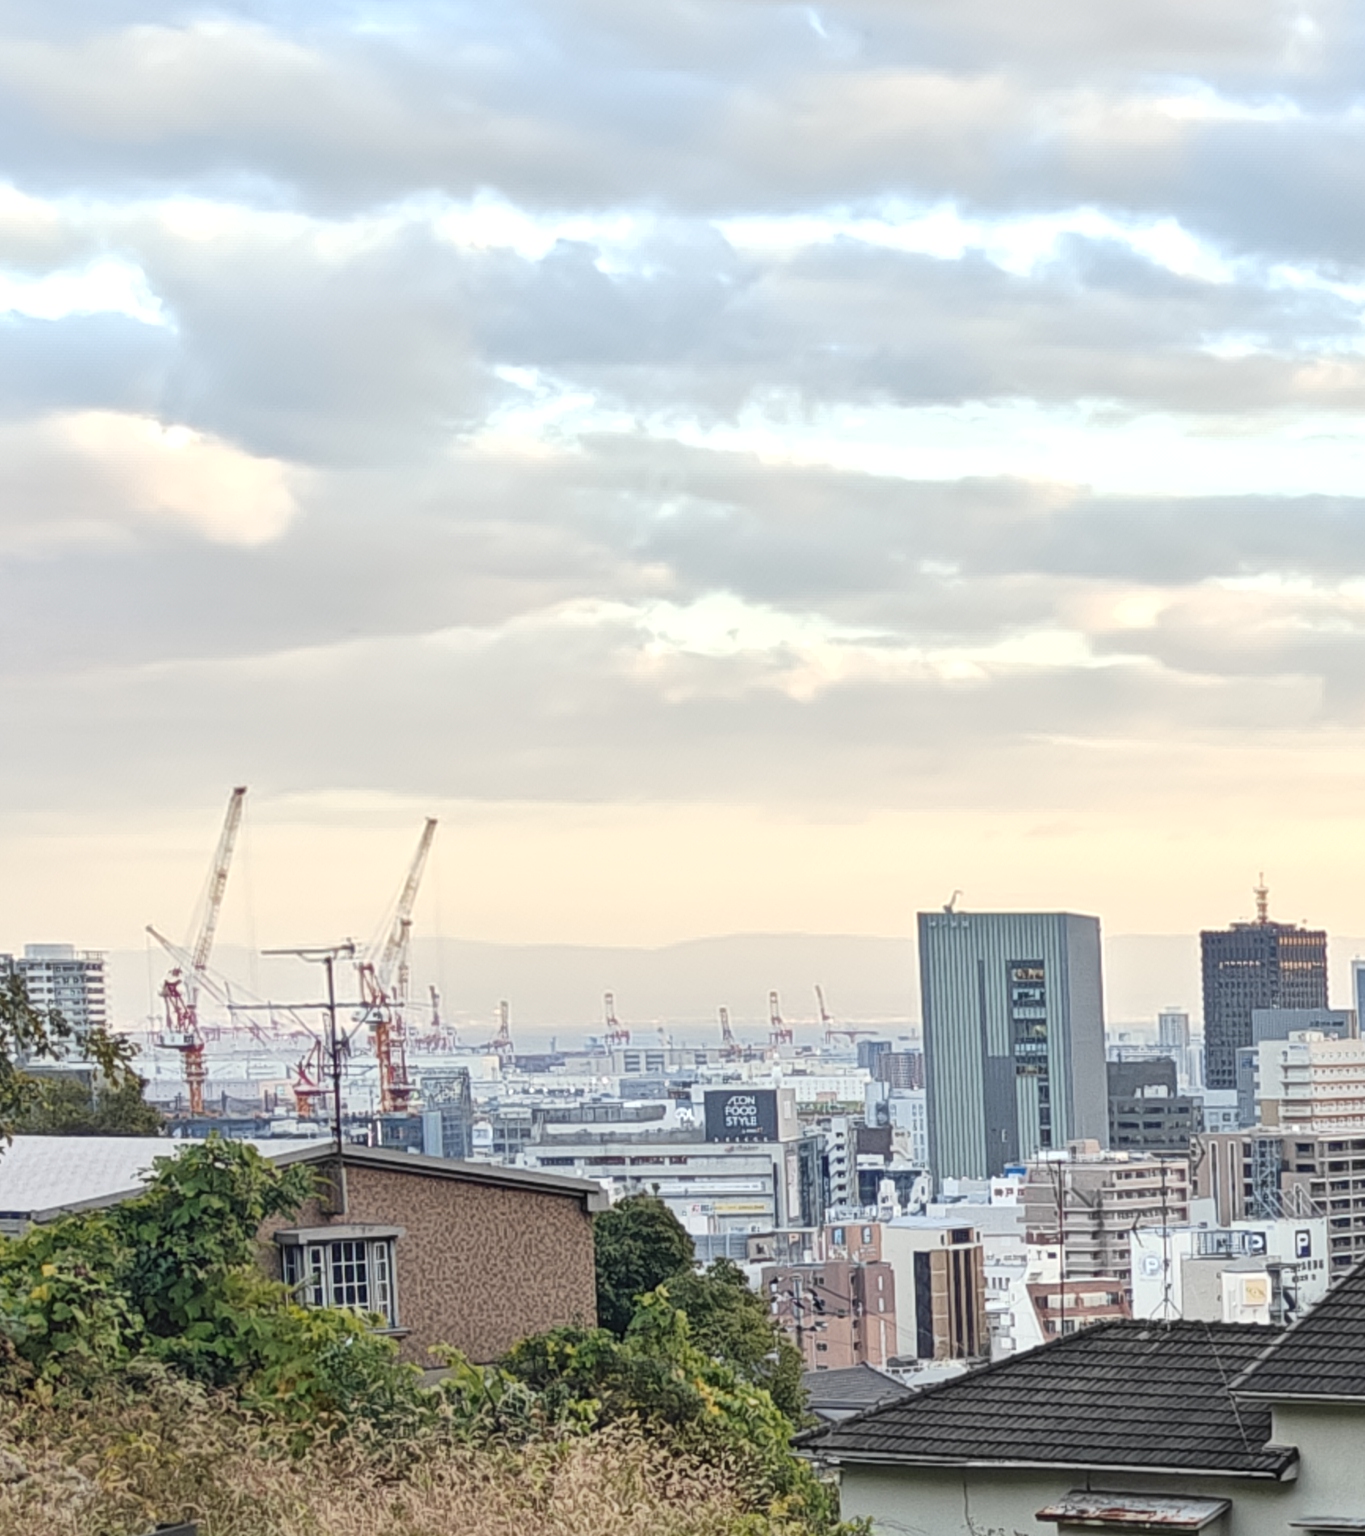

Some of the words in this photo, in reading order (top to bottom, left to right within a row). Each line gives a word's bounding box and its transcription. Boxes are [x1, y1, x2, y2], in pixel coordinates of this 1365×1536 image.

[725, 1105, 757, 1116] FOOD
[725, 1116, 757, 1127] STYLE
[1245, 1234, 1264, 1253] P
[1297, 1233, 1308, 1256] P
[1145, 1257, 1158, 1273] P
